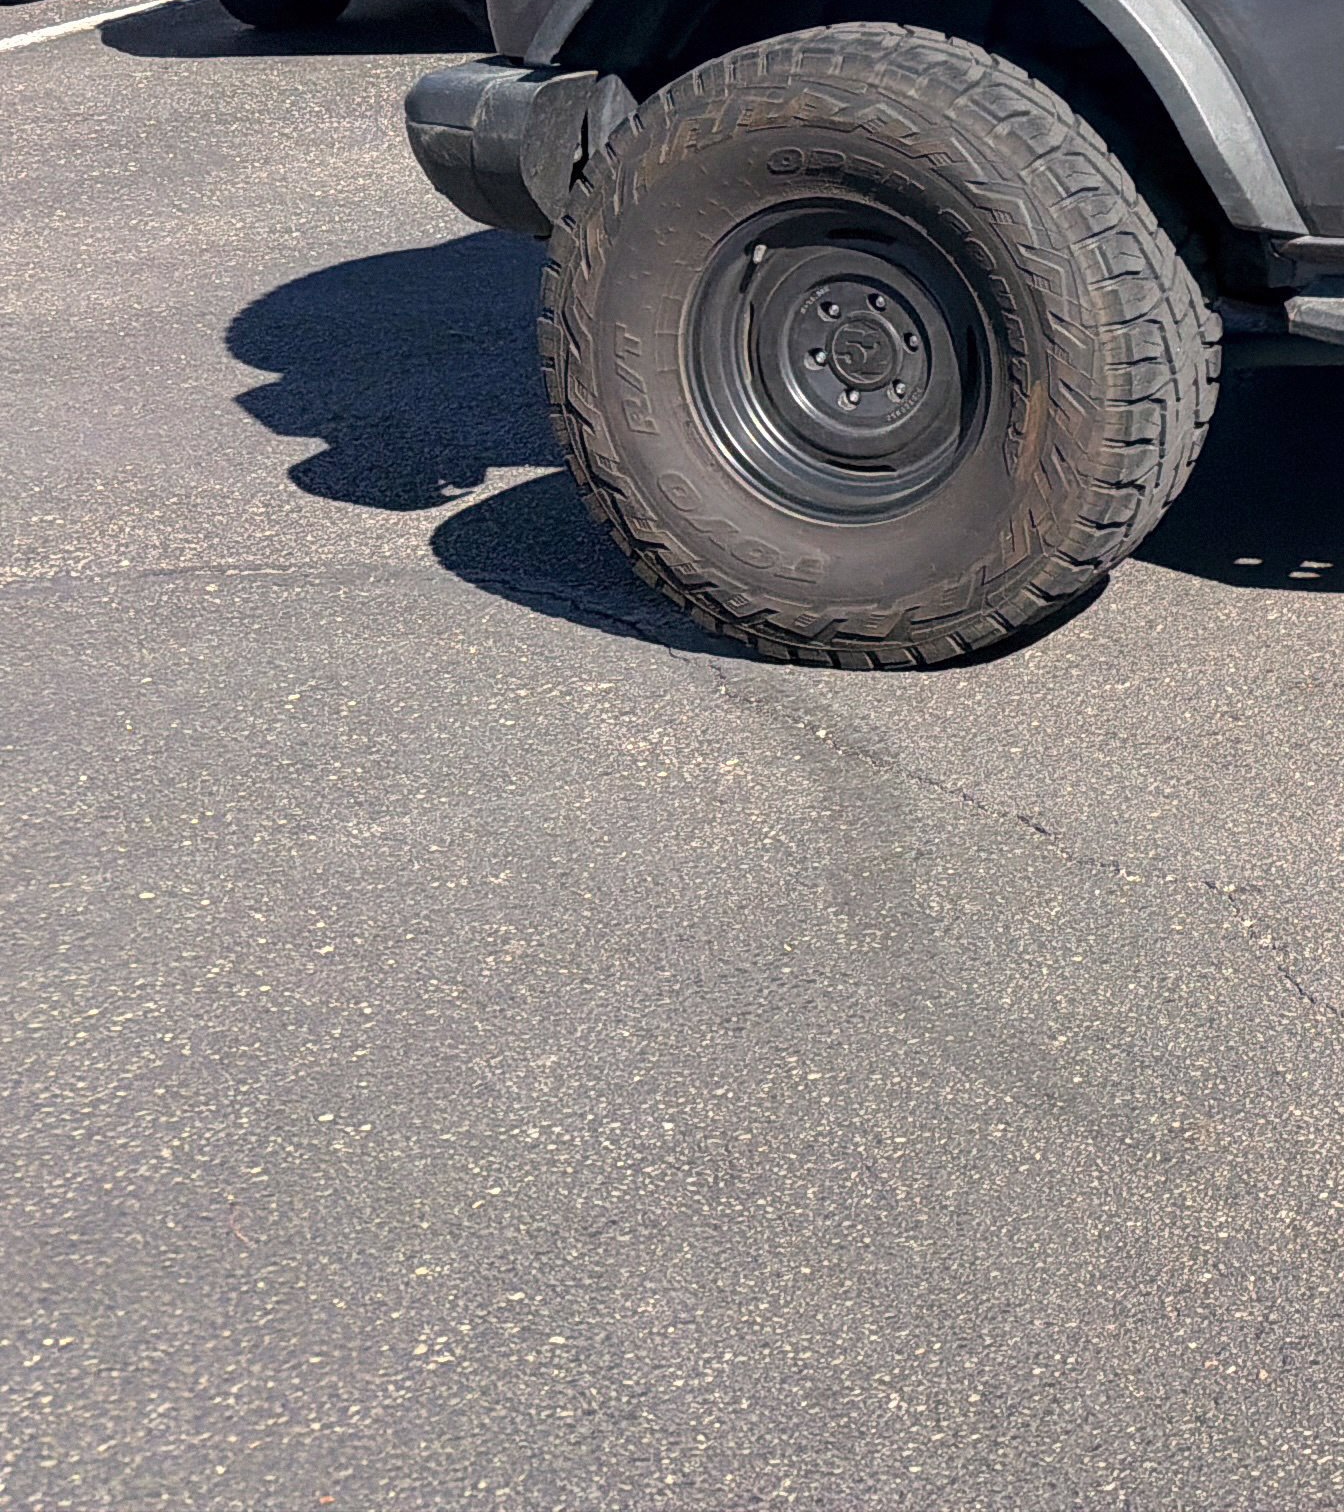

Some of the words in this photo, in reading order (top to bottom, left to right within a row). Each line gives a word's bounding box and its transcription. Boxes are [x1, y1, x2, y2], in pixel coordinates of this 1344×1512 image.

[766, 147, 925, 191] OPEN
[614, 321, 659, 435] R/T
[657, 471, 826, 584] TOYO
